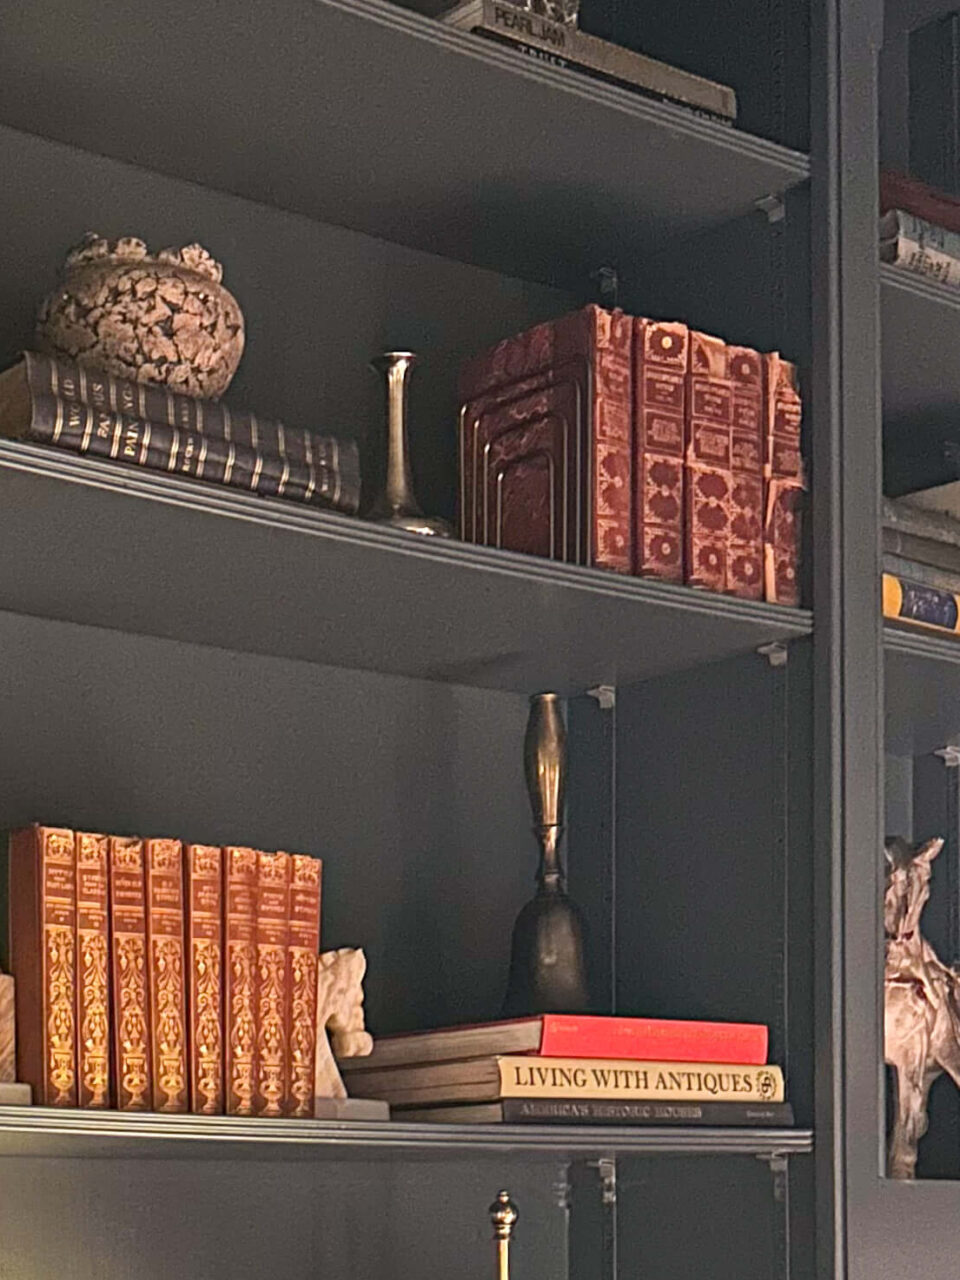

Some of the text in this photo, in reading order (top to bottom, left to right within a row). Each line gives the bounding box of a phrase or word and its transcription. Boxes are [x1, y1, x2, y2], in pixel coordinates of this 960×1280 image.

[494, 6, 566, 47] PEARL JAM
[514, 1065, 753, 1095] LIVING WITH ANTIQUES
